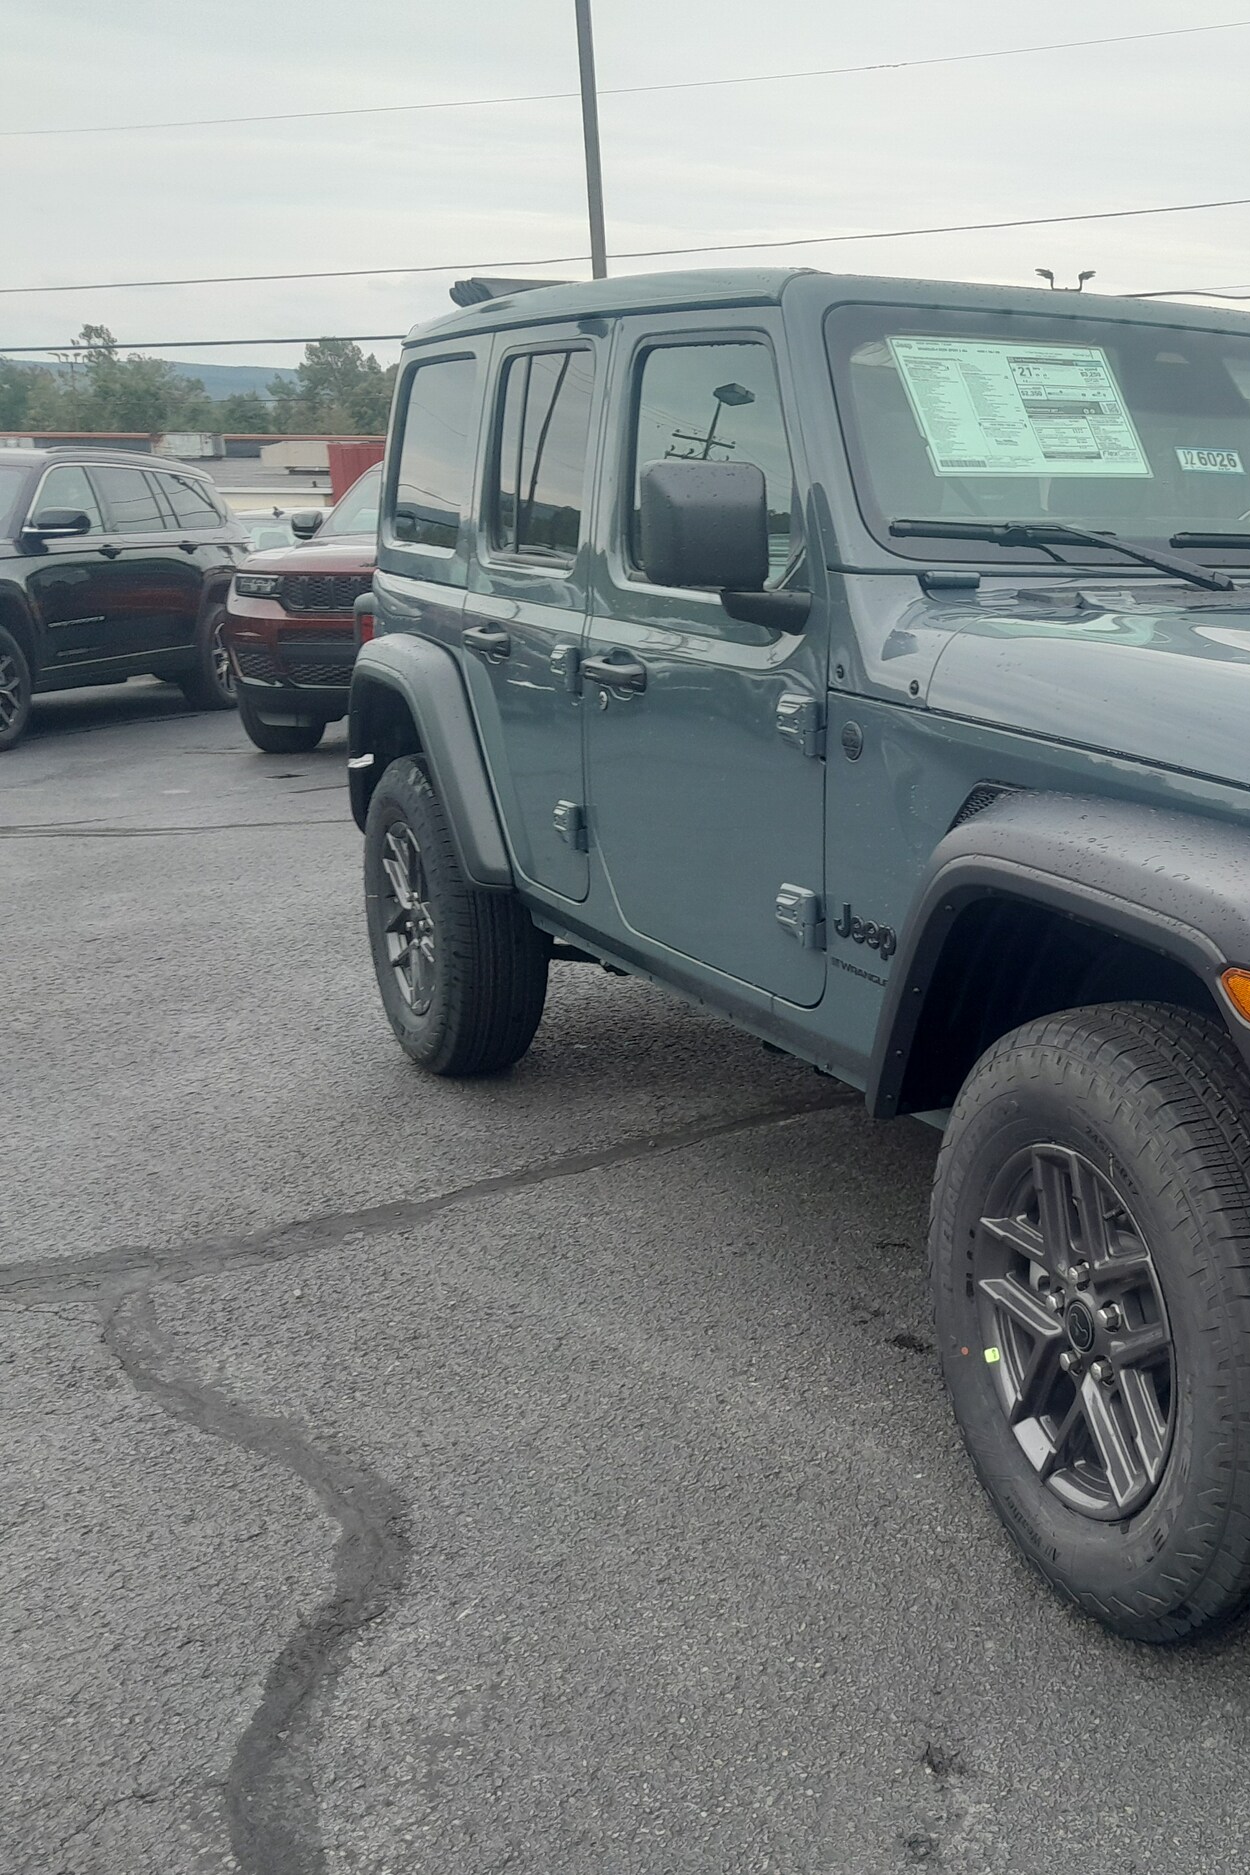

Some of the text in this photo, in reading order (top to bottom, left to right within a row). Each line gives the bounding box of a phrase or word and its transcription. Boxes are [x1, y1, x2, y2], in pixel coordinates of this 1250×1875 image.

[1018, 366, 1033, 377] 21
[1196, 451, 1237, 468] 6026
[833, 902, 897, 961] Jeep
